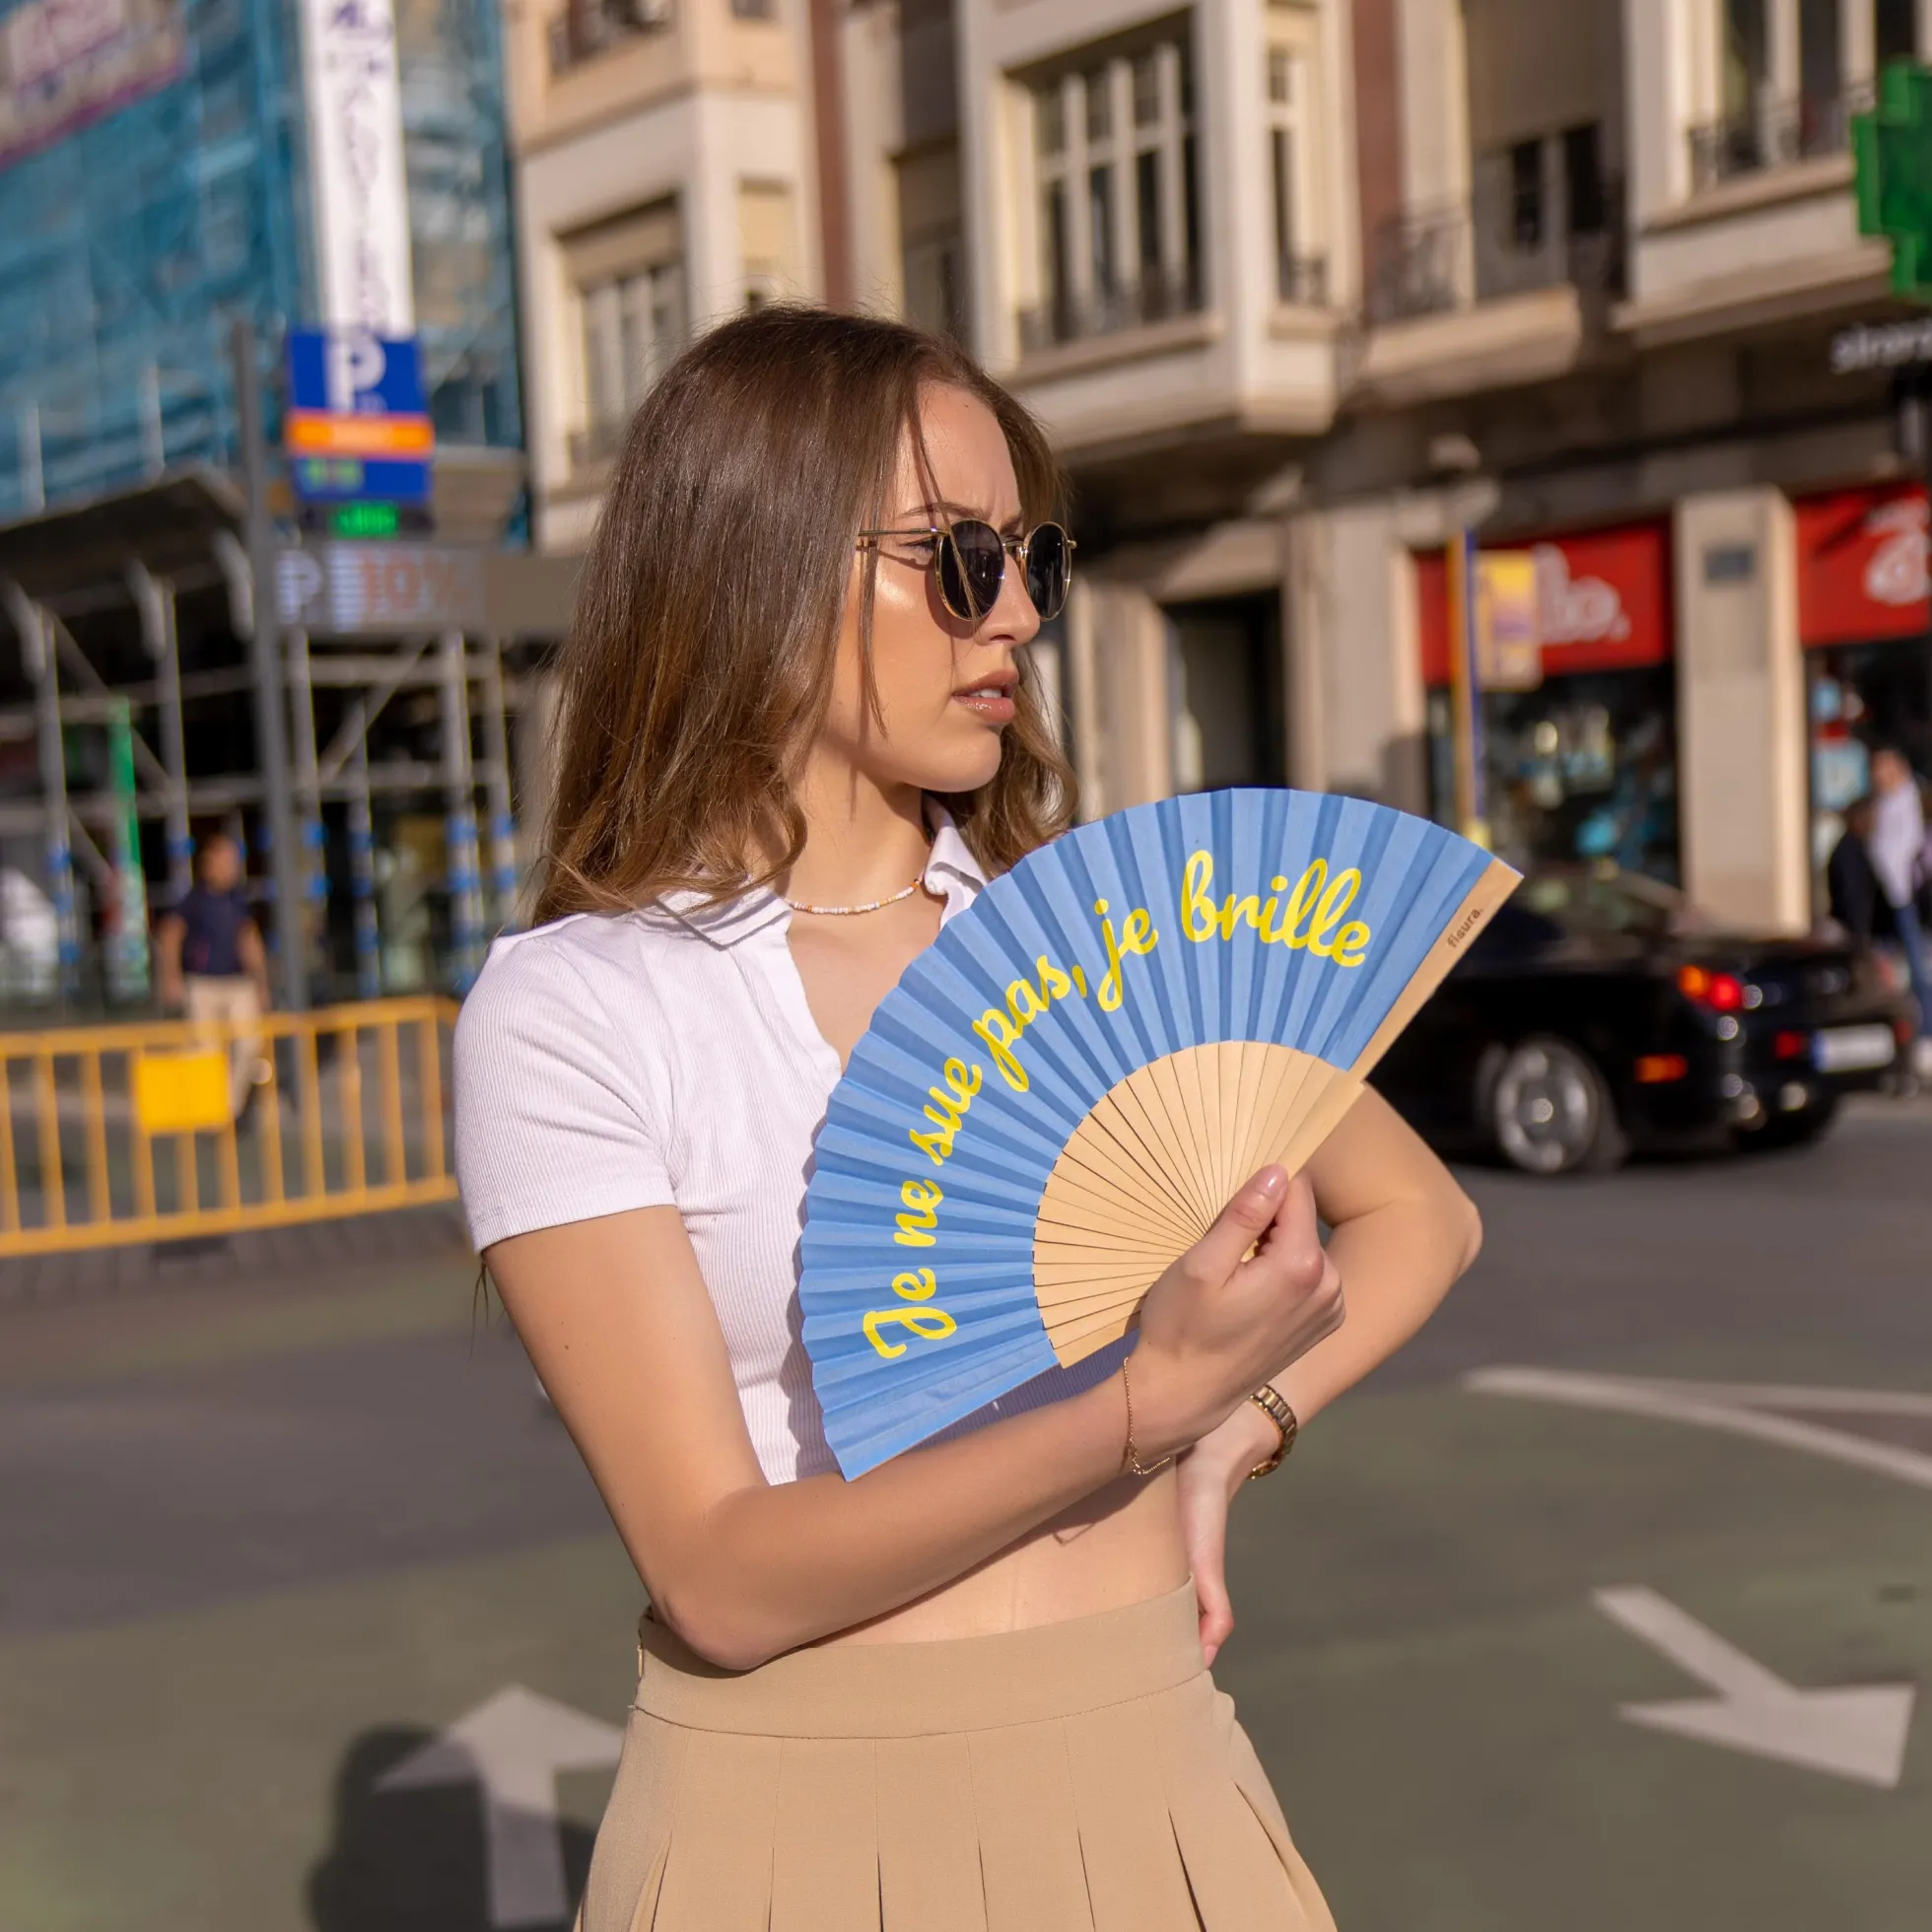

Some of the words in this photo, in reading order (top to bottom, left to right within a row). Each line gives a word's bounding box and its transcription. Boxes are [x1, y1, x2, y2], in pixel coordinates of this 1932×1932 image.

[1094, 899, 1157, 1011] je
[1180, 849, 1371, 967] brille
[972, 955, 1088, 1091] pas,
[909, 1058, 982, 1165] sue
[894, 1180, 942, 1246] ne
[862, 1269, 956, 1358] Je
